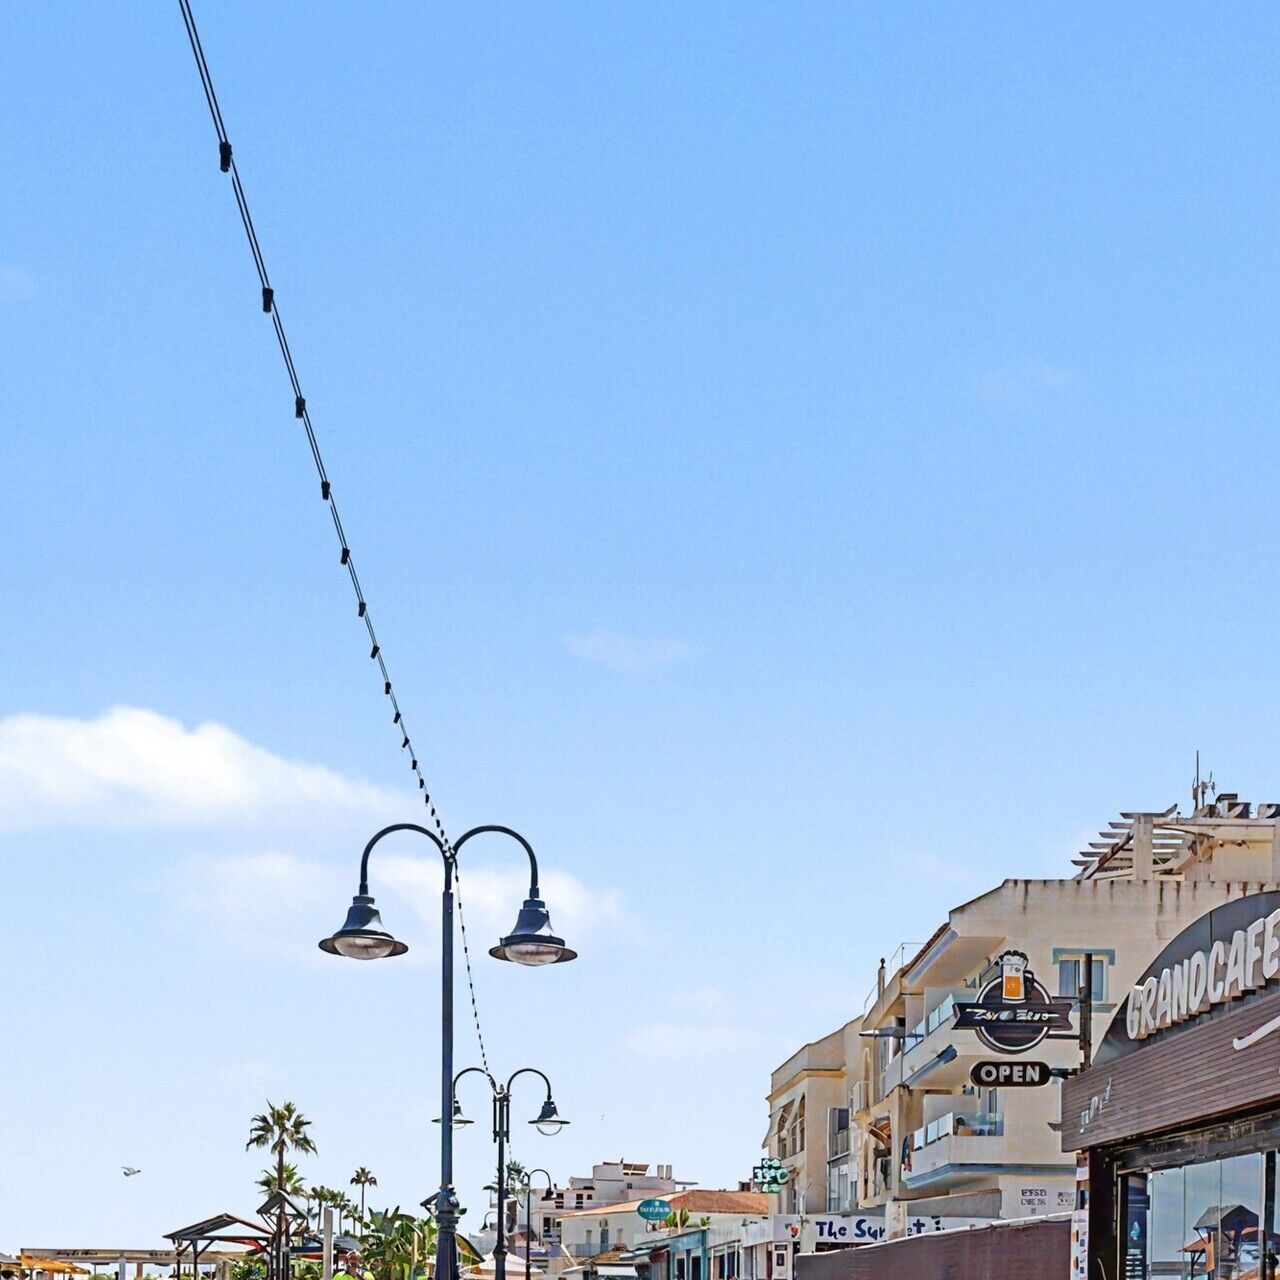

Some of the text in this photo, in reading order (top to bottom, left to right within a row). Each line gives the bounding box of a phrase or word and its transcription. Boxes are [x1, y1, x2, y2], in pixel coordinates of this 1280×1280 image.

[980, 1065, 1040, 1083] OPEN
[815, 1221, 847, 1240] The
[854, 1218, 925, 1241] Sunet
